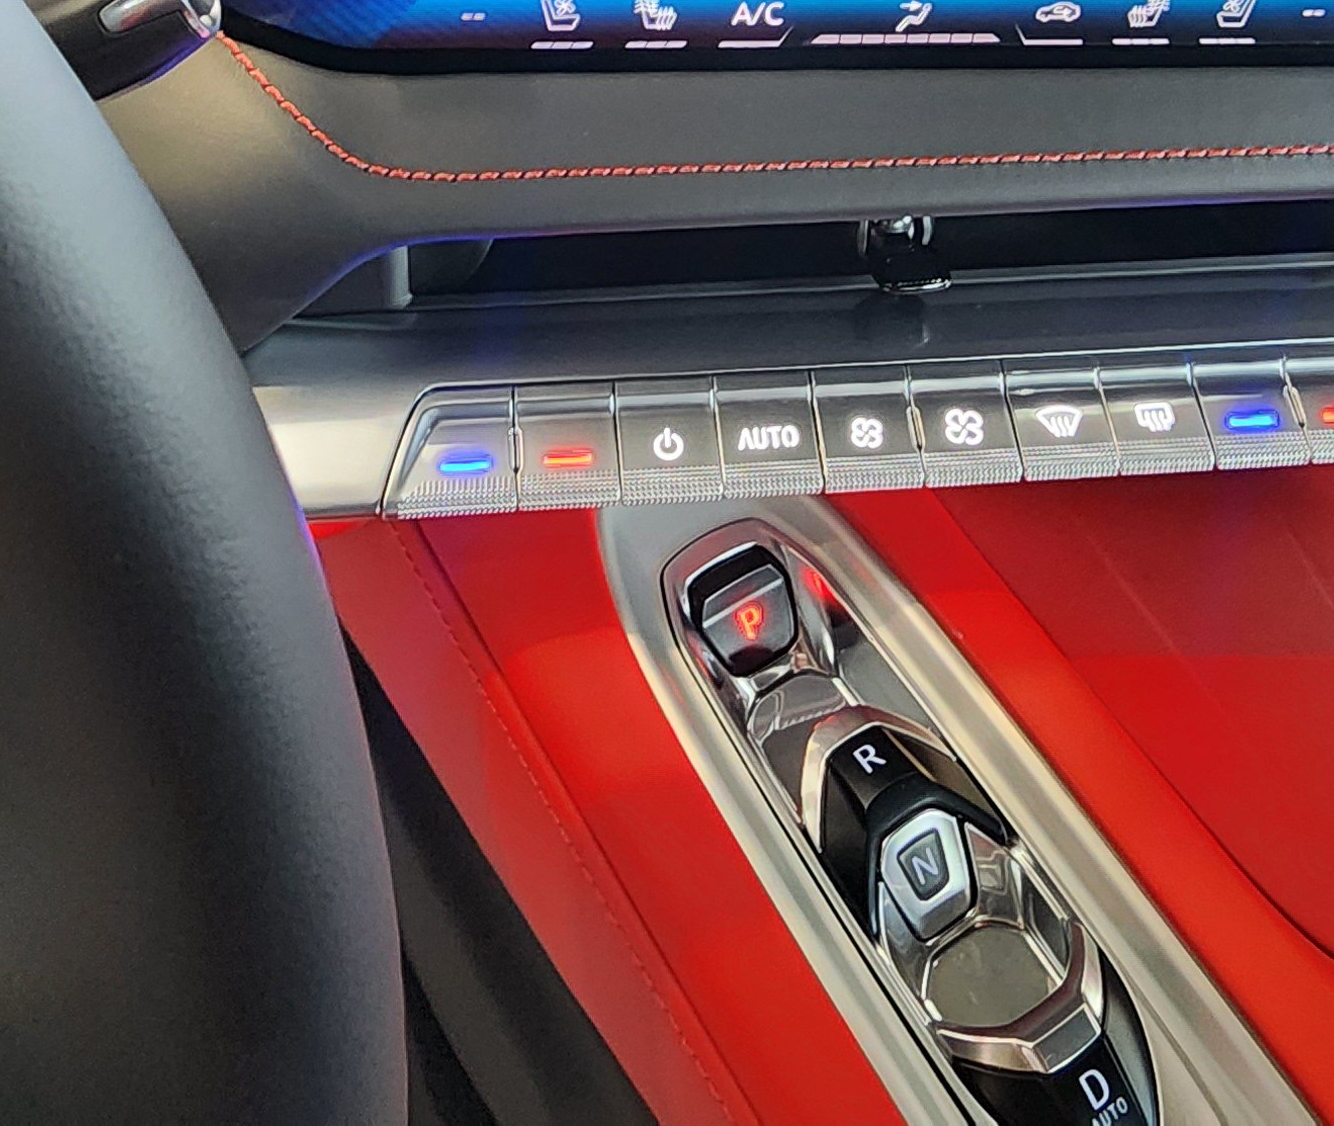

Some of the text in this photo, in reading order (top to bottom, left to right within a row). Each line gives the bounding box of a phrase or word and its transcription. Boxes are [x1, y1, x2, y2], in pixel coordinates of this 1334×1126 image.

[730, 0, 785, 26] A/C
[737, 424, 801, 451] AUTO
[737, 604, 763, 641] P
[852, 744, 887, 774] R
[910, 846, 940, 886] N
[1078, 1068, 1110, 1111] D
